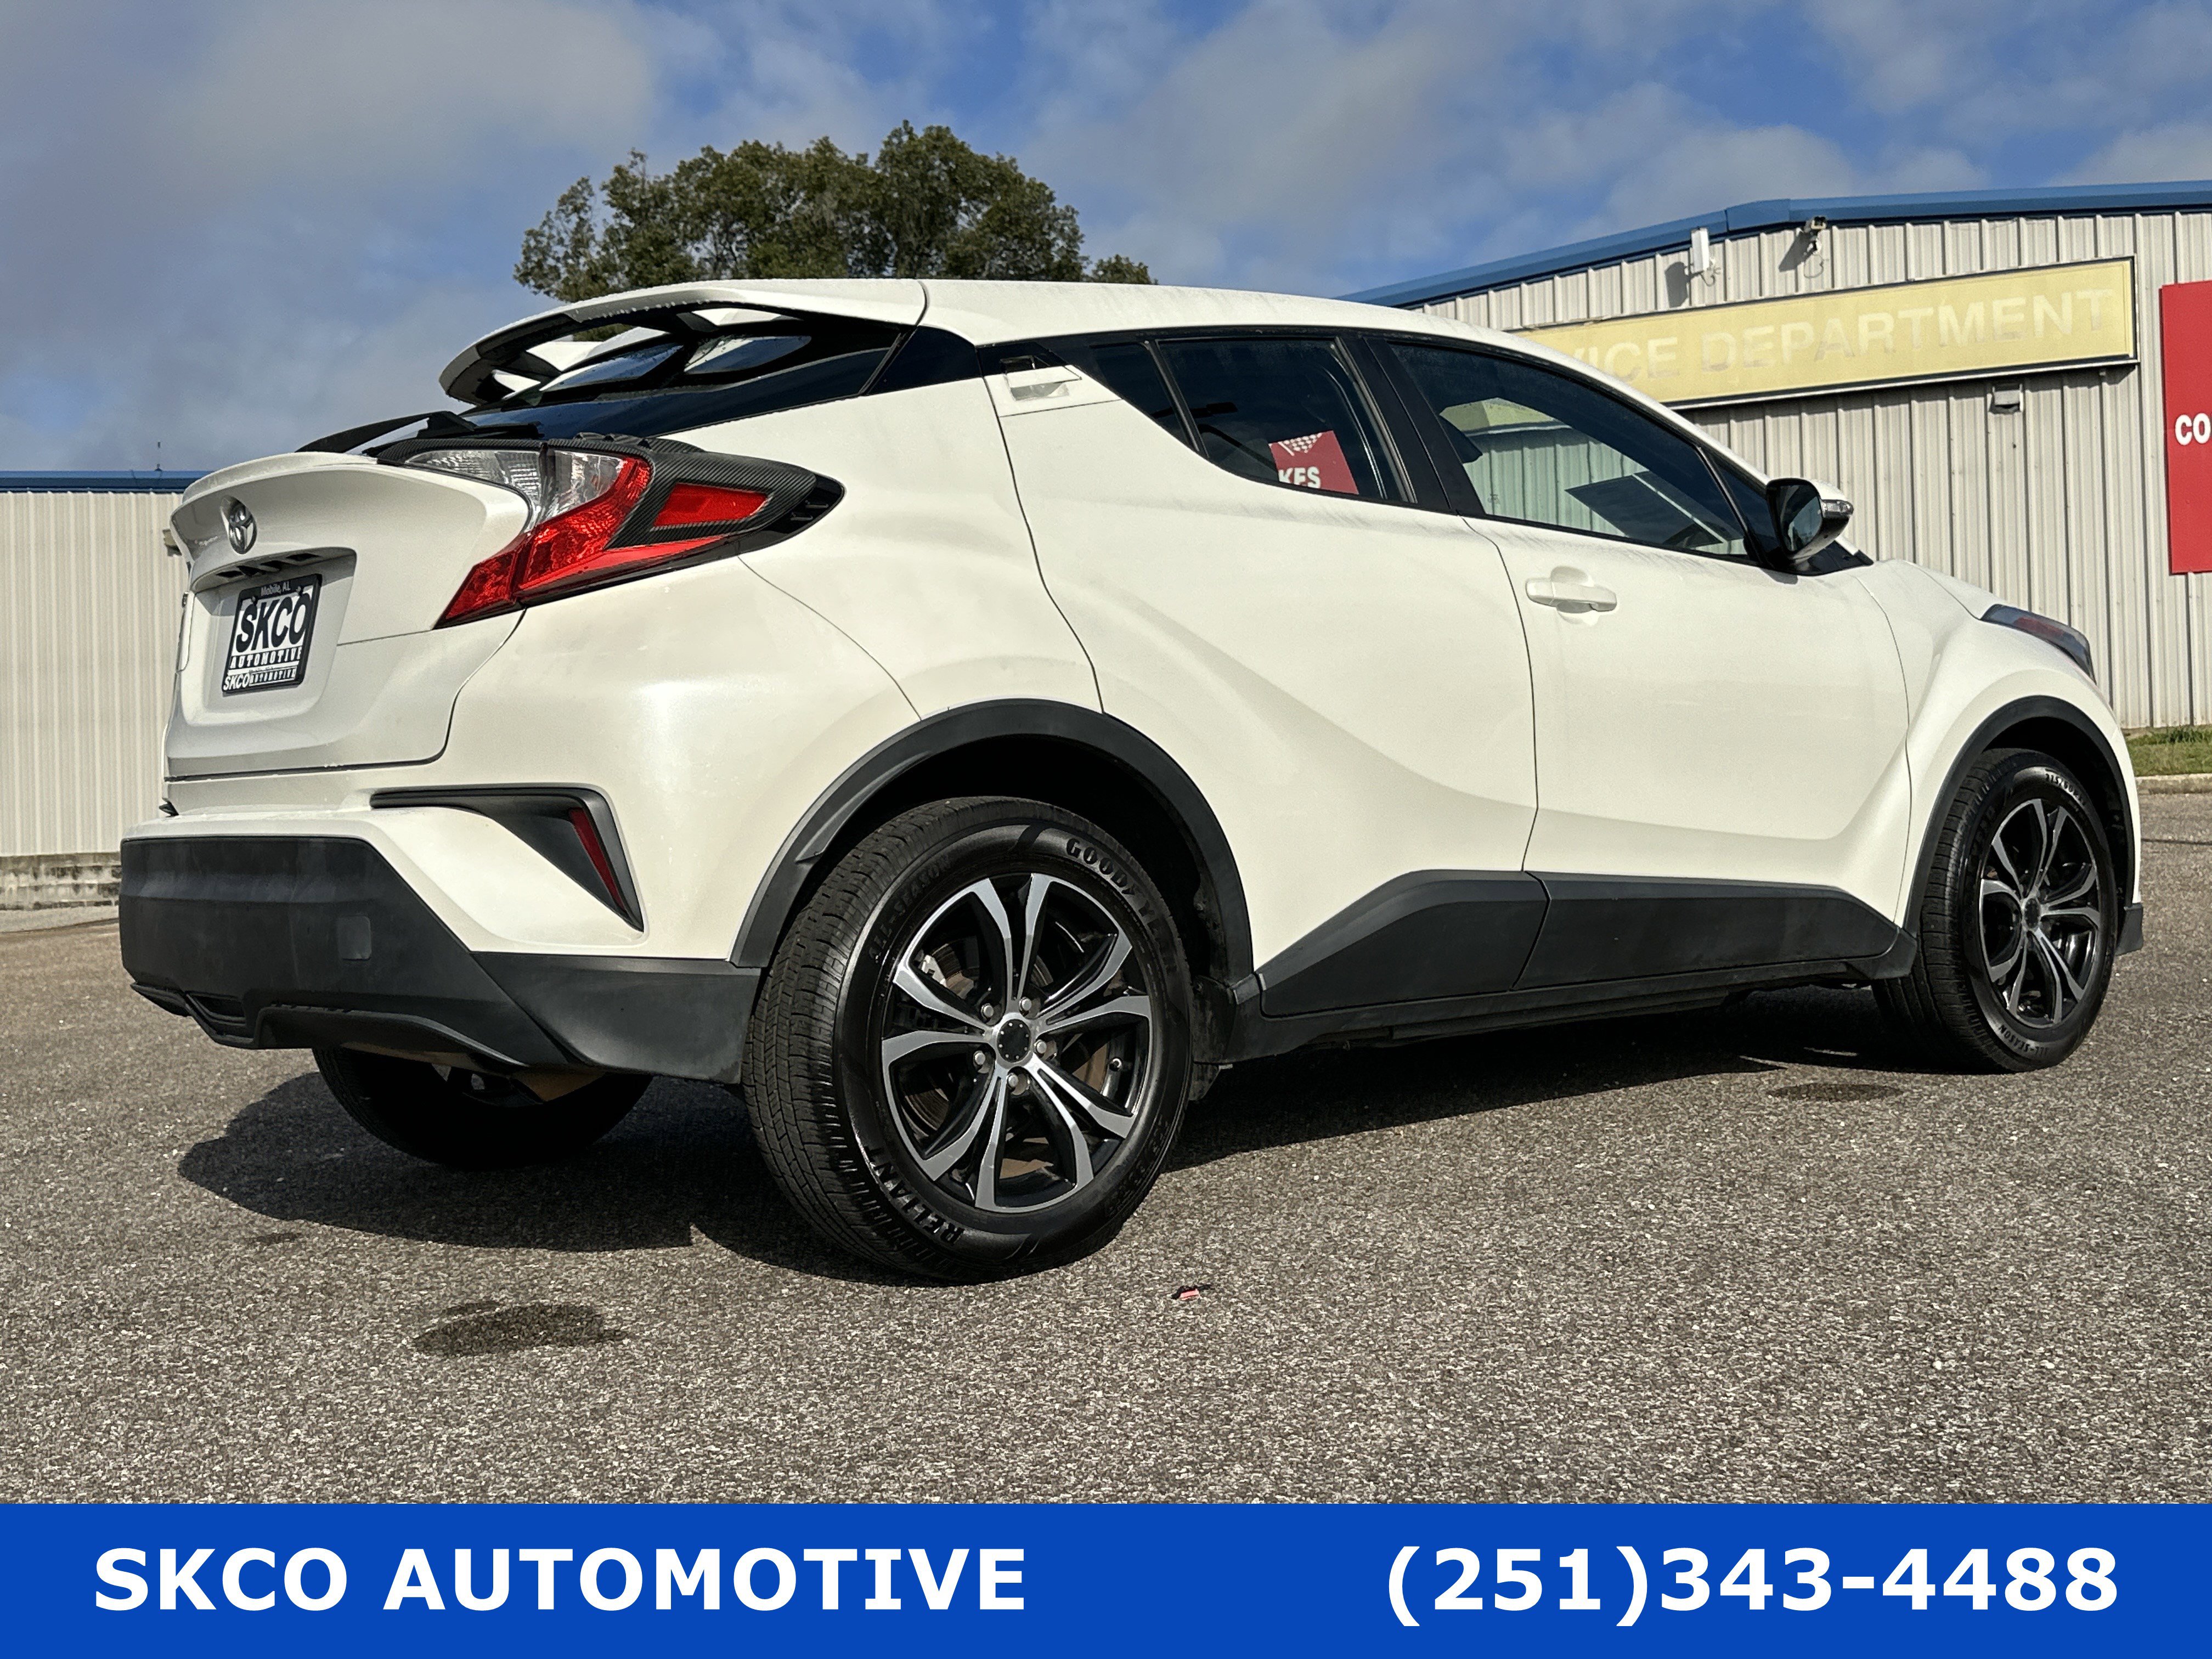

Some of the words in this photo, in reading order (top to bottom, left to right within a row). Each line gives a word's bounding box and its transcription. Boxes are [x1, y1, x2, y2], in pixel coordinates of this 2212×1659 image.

[1701, 289, 2114, 373] DEPARTMENT
[236, 592, 312, 653] SKCO
[223, 673, 250, 691] SKCO
[230, 646, 302, 669] AUTOMOTIVE
[864, 1146, 965, 1245] RELIANT
